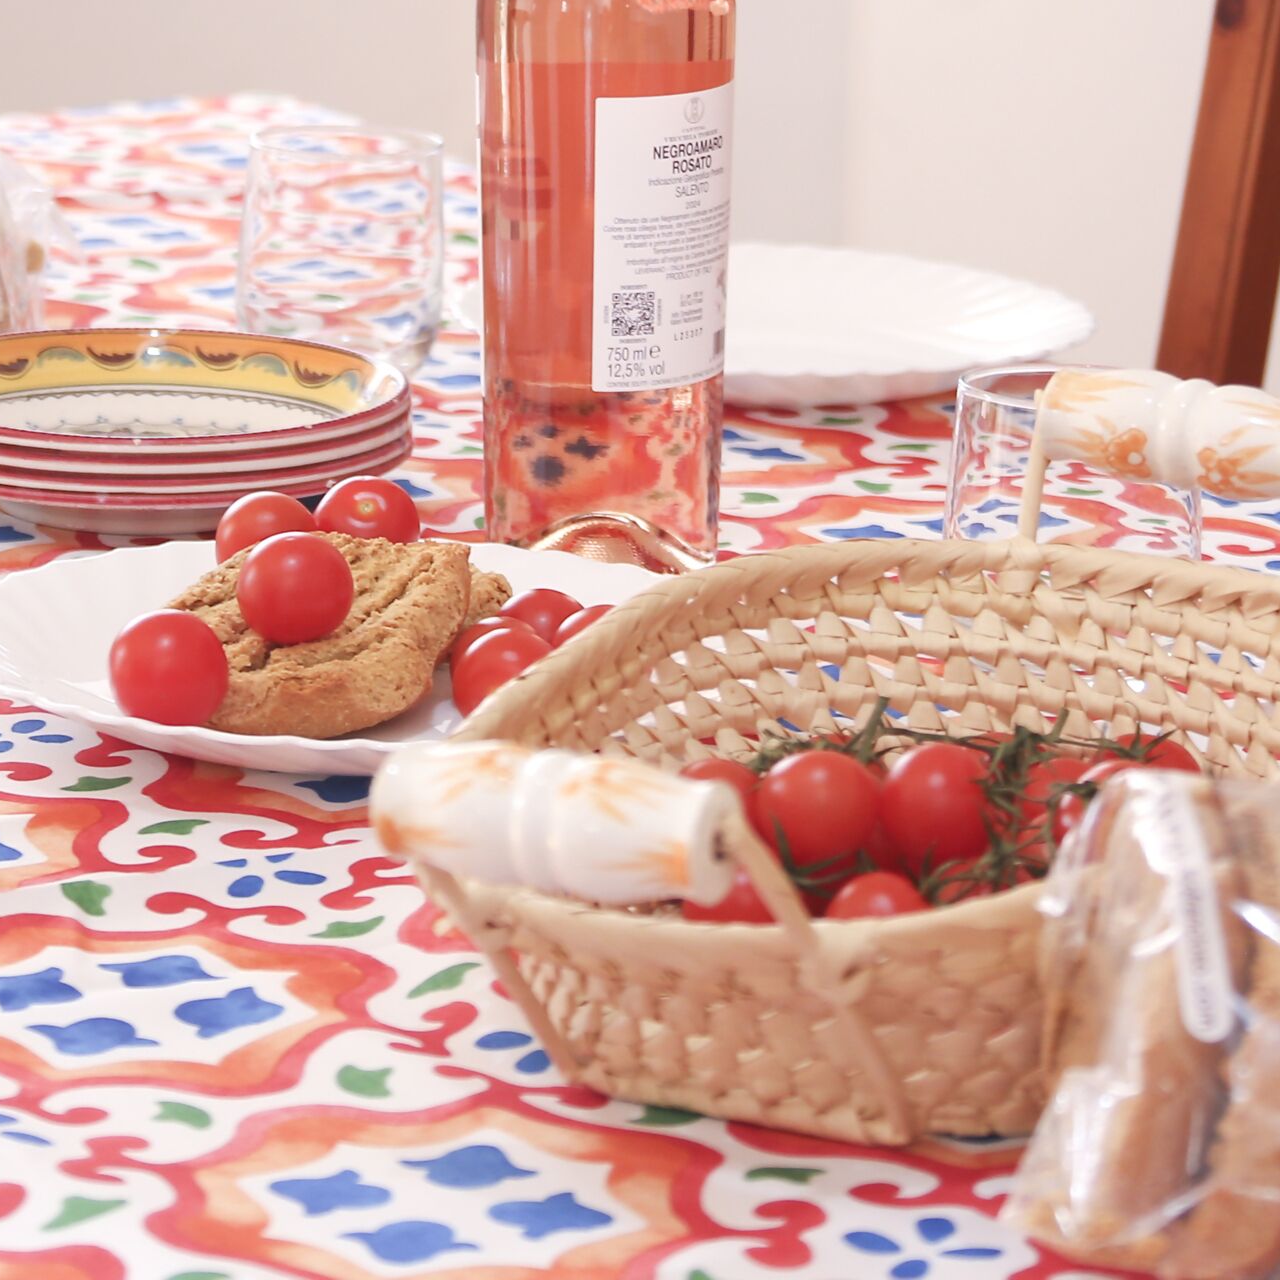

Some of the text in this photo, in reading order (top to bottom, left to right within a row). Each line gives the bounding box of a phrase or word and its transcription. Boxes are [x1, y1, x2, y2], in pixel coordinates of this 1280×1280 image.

[653, 135, 723, 160] NEGROAMARO
[672, 154, 712, 174] ROSATO
[675, 181, 709, 198] SALENTO
[607, 347, 629, 361] 750
[633, 346, 647, 360] ml
[608, 363, 646, 379] 12,5%
[649, 360, 665, 376] vol
